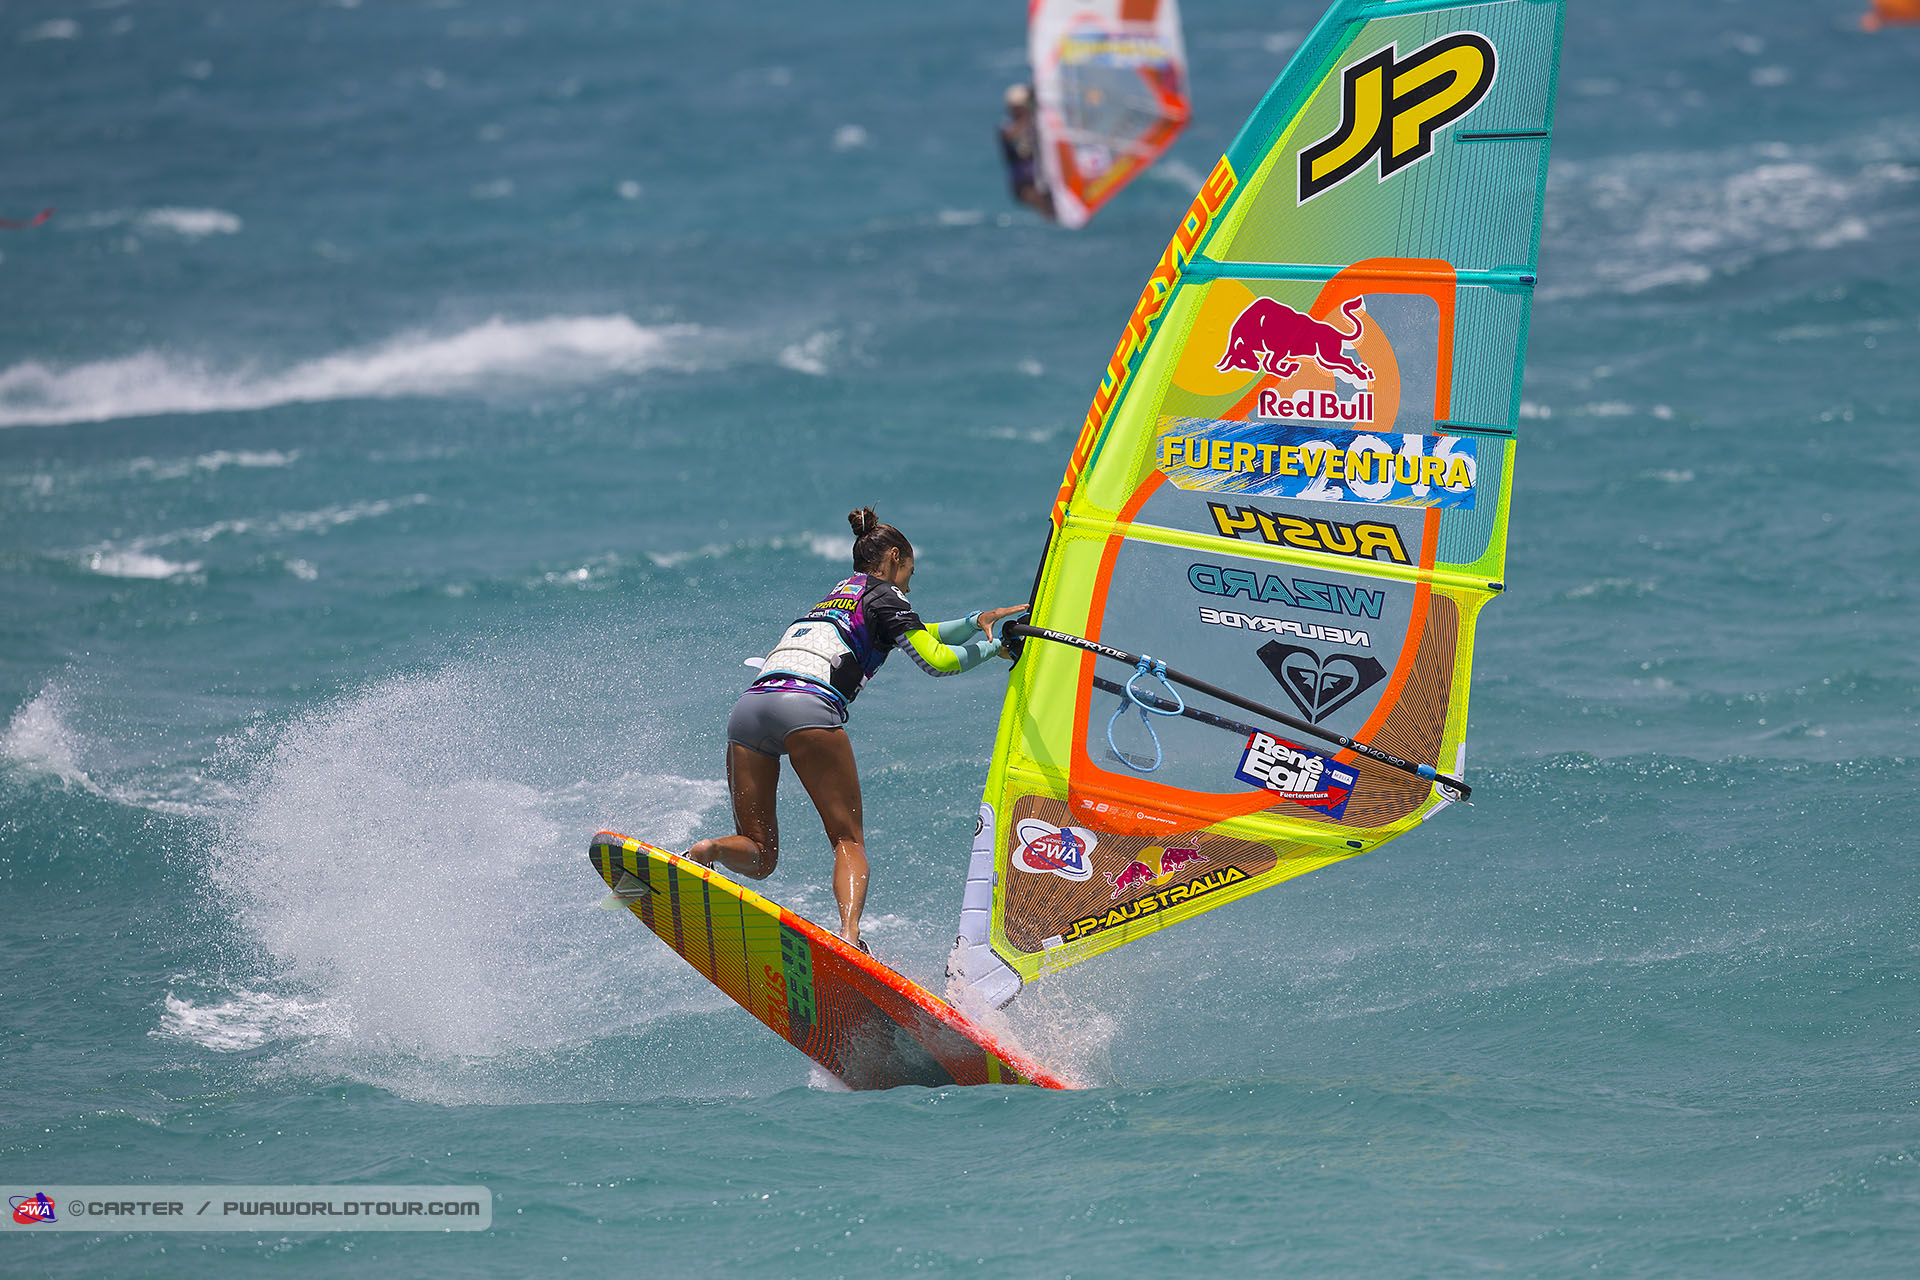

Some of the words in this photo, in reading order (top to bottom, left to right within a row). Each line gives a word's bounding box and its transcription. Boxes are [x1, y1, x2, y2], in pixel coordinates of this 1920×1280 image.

[1300, 33, 1496, 203] JP
[1051, 153, 1238, 528] NEILPRYDE
[1260, 391, 1313, 417] Red
[1320, 393, 1373, 420] Bull
[1163, 436, 1472, 488] FUERTEVENTURA
[1043, 630, 1128, 660] NEILPRYDE
[1242, 749, 1320, 792] Egli
[1251, 732, 1324, 774] René
[1080, 799, 1109, 813] 3.8
[1280, 791, 1328, 799] Fuerteventura
[1031, 841, 1077, 863] PWA
[1066, 867, 1246, 940] JP-AUSTRALIA
